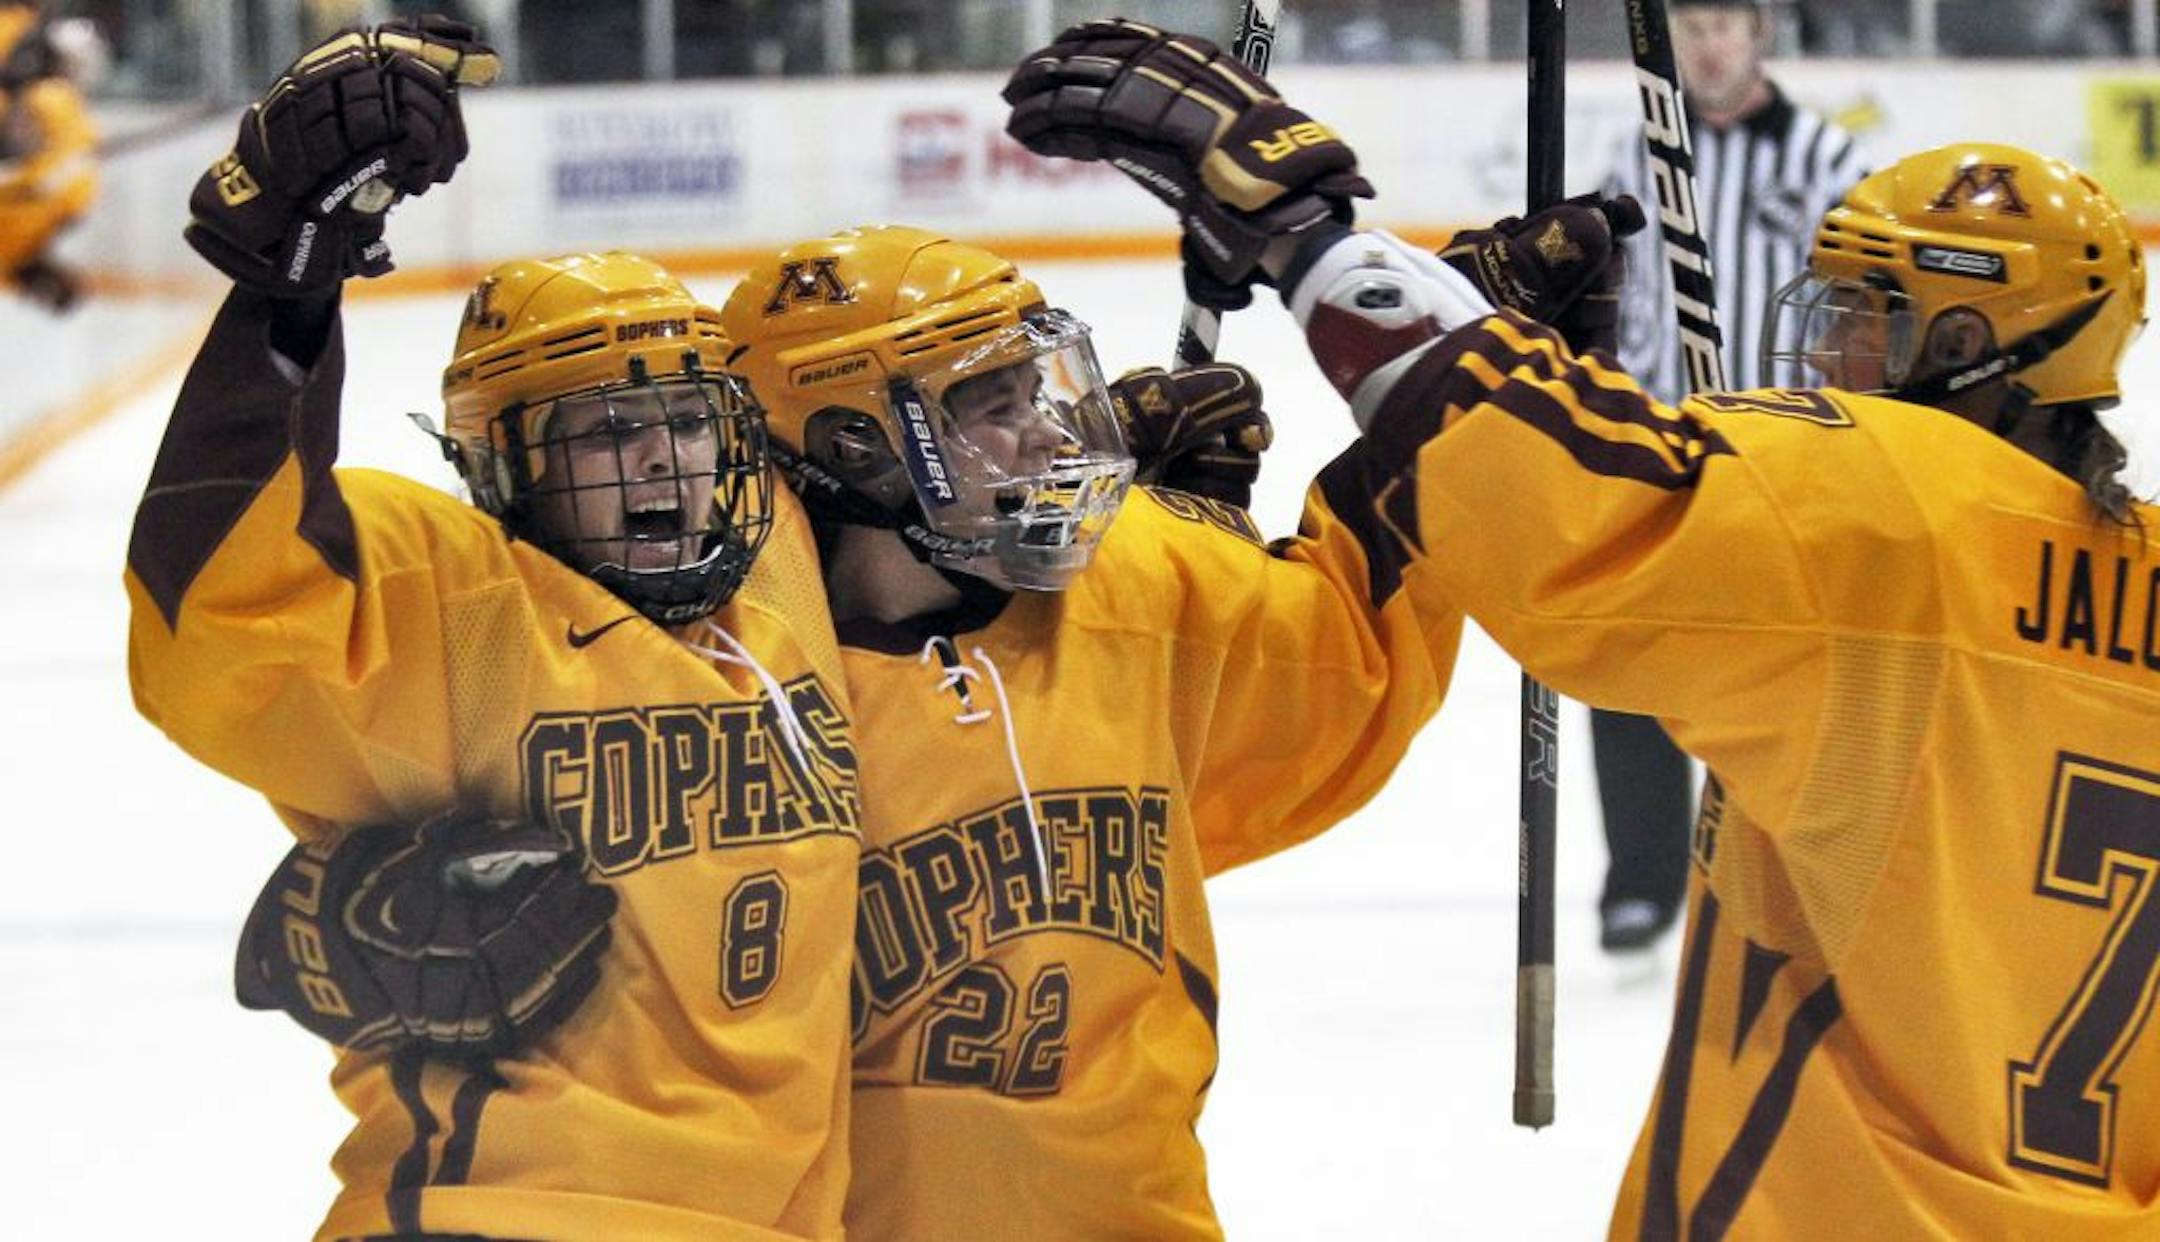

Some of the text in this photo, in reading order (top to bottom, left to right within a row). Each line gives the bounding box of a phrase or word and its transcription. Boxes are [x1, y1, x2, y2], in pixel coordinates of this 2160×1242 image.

[1636, 65, 1727, 396] BAUE
[616, 318, 690, 342] GOPHERS
[799, 358, 869, 386] BAUER
[904, 401, 953, 500] BAUER
[721, 870, 789, 1009] 8
[852, 785, 1170, 1047] OPHERS
[2007, 749, 2160, 1190] 7
[914, 962, 1073, 1097] 22
